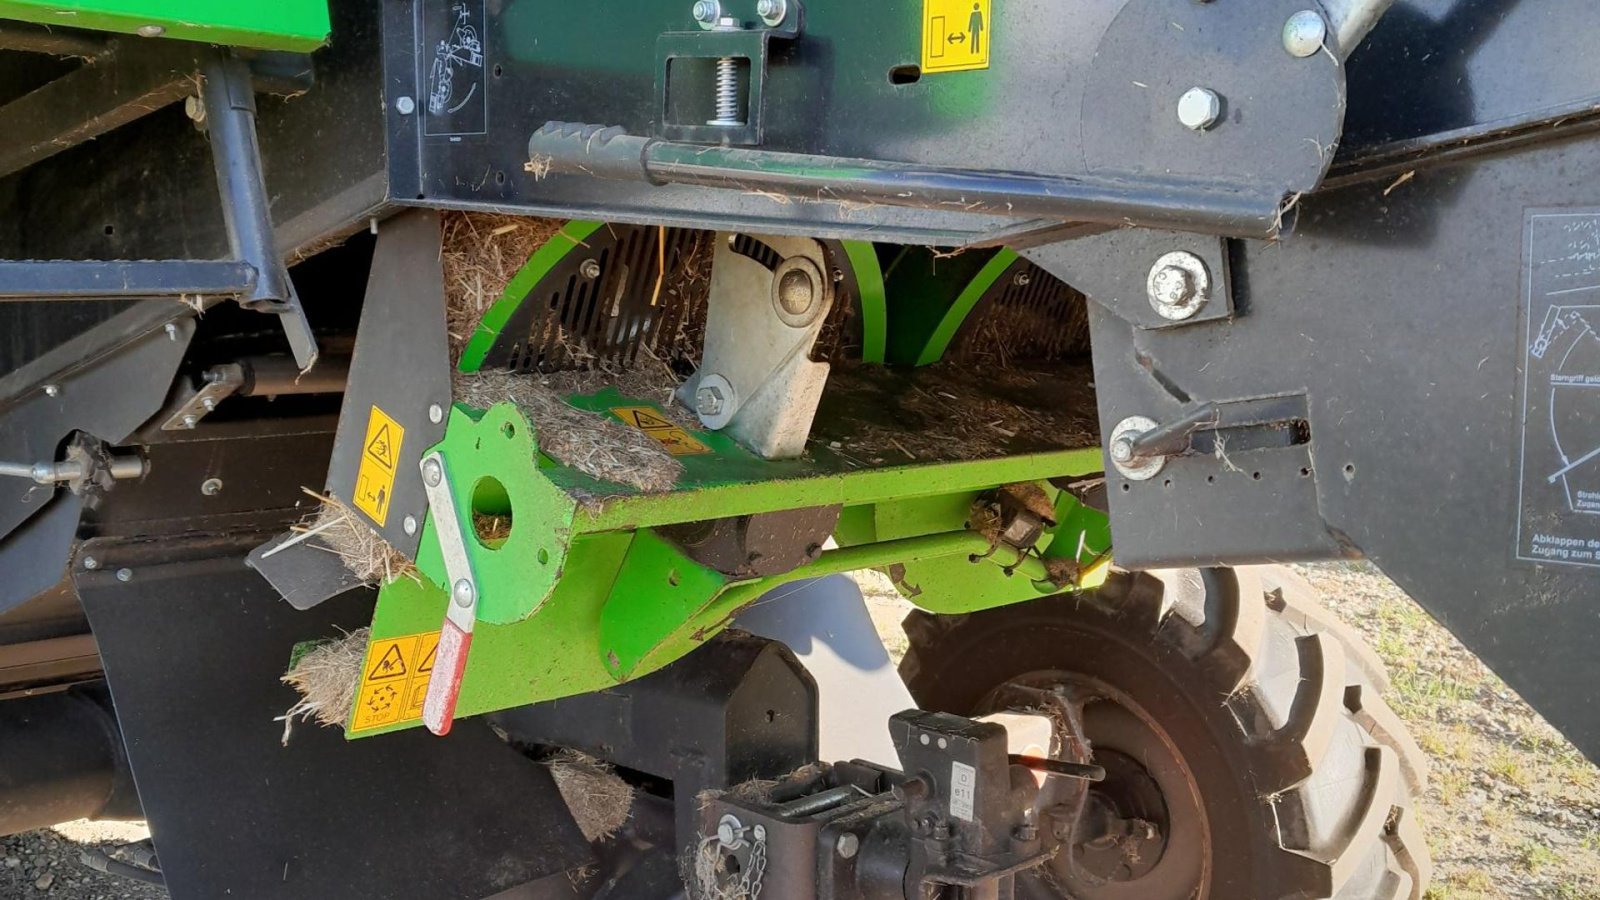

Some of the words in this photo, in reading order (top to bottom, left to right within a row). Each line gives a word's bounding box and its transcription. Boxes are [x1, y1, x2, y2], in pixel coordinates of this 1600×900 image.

[1532, 534, 1585, 547] Abklappen
[1532, 545, 1569, 558] Zugang
[1571, 550, 1593, 559] zum
[364, 712, 390, 724] STOP
